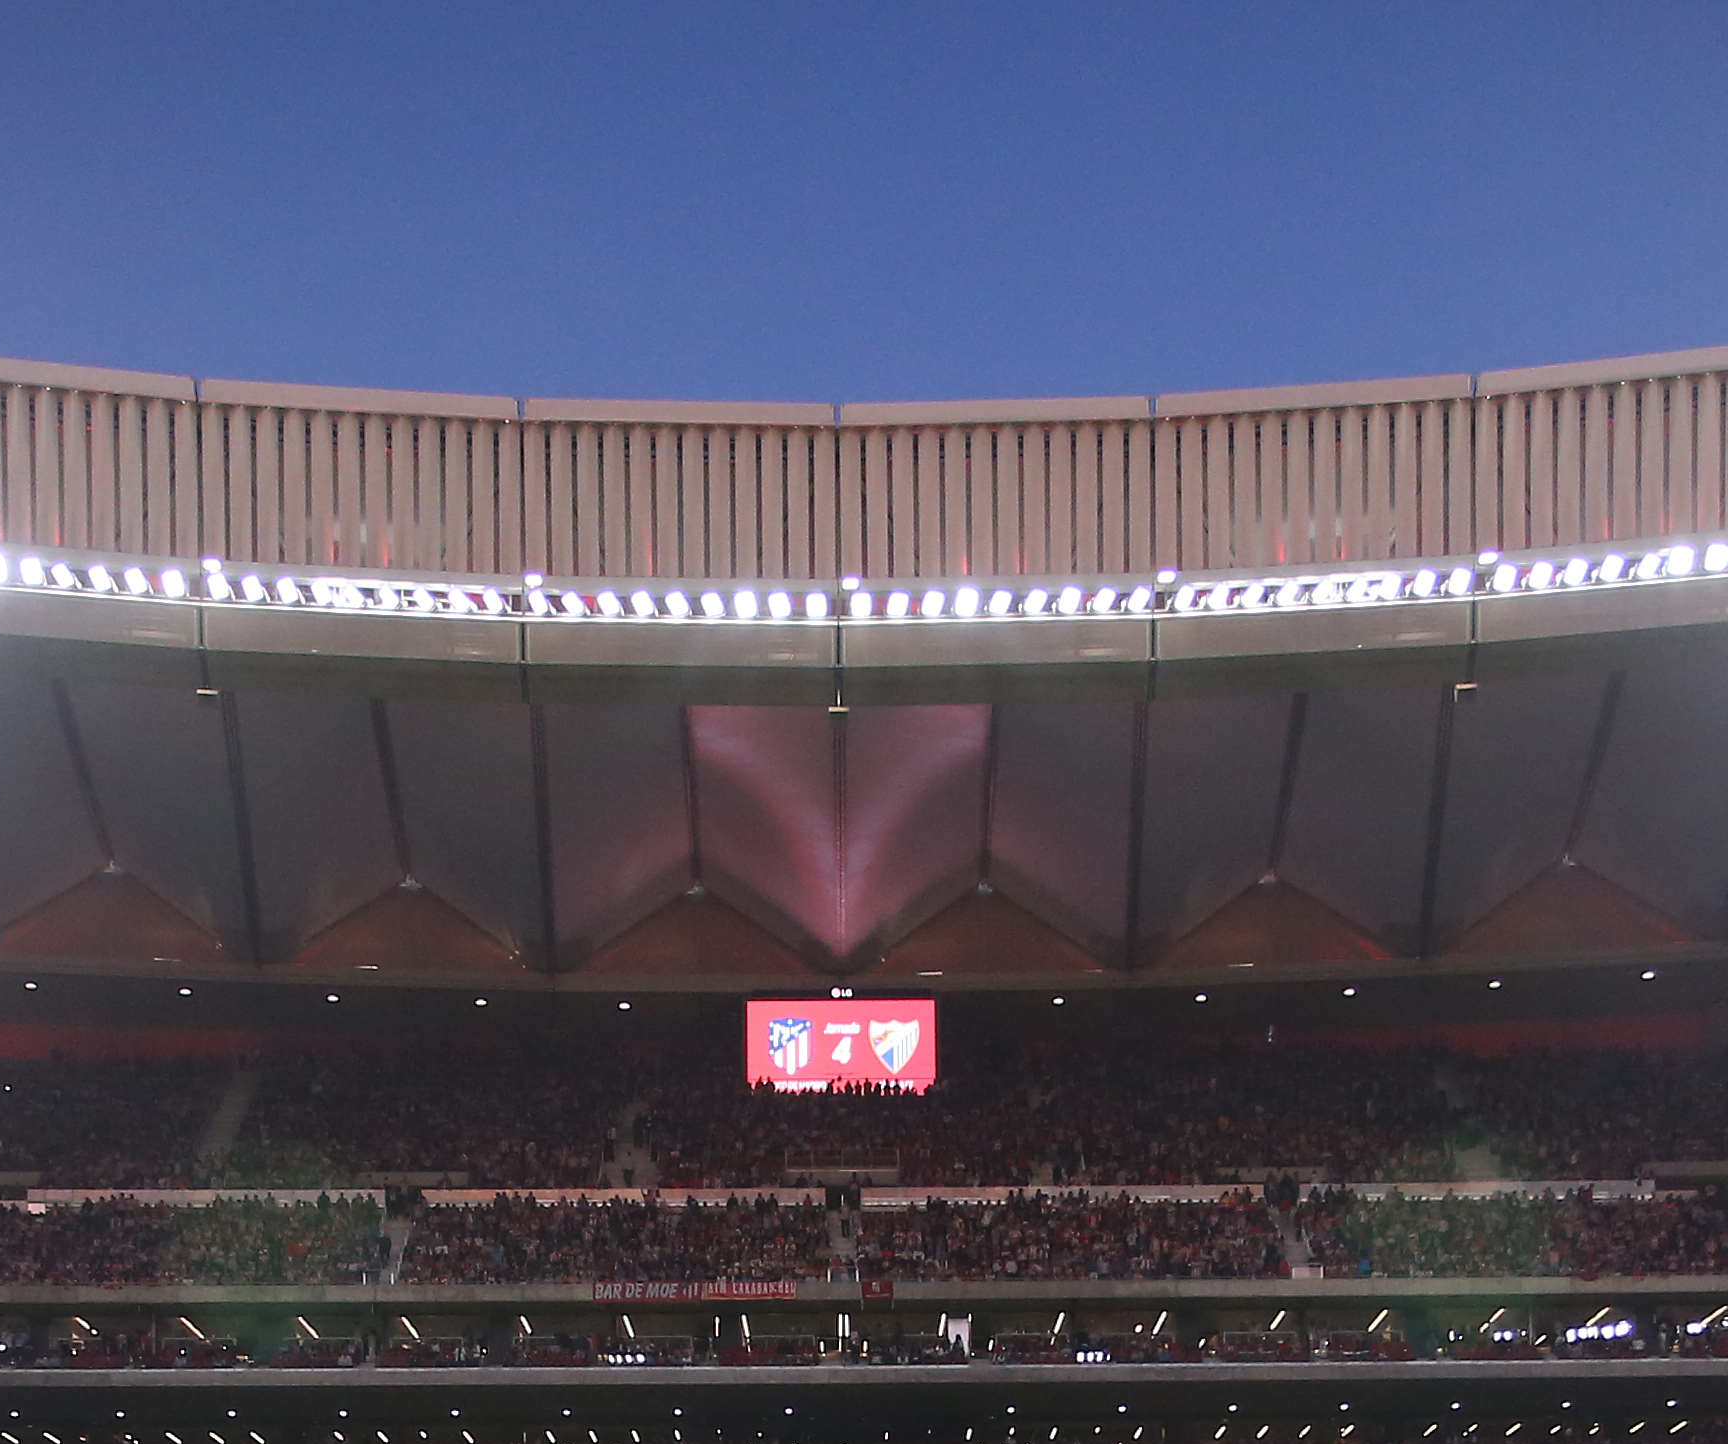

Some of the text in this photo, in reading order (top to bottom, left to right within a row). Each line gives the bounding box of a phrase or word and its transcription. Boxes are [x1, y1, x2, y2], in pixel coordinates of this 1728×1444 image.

[841, 988, 853, 998] LG
[832, 1037, 852, 1065] 4
[595, 1282, 679, 1300] BAR DE MOE
